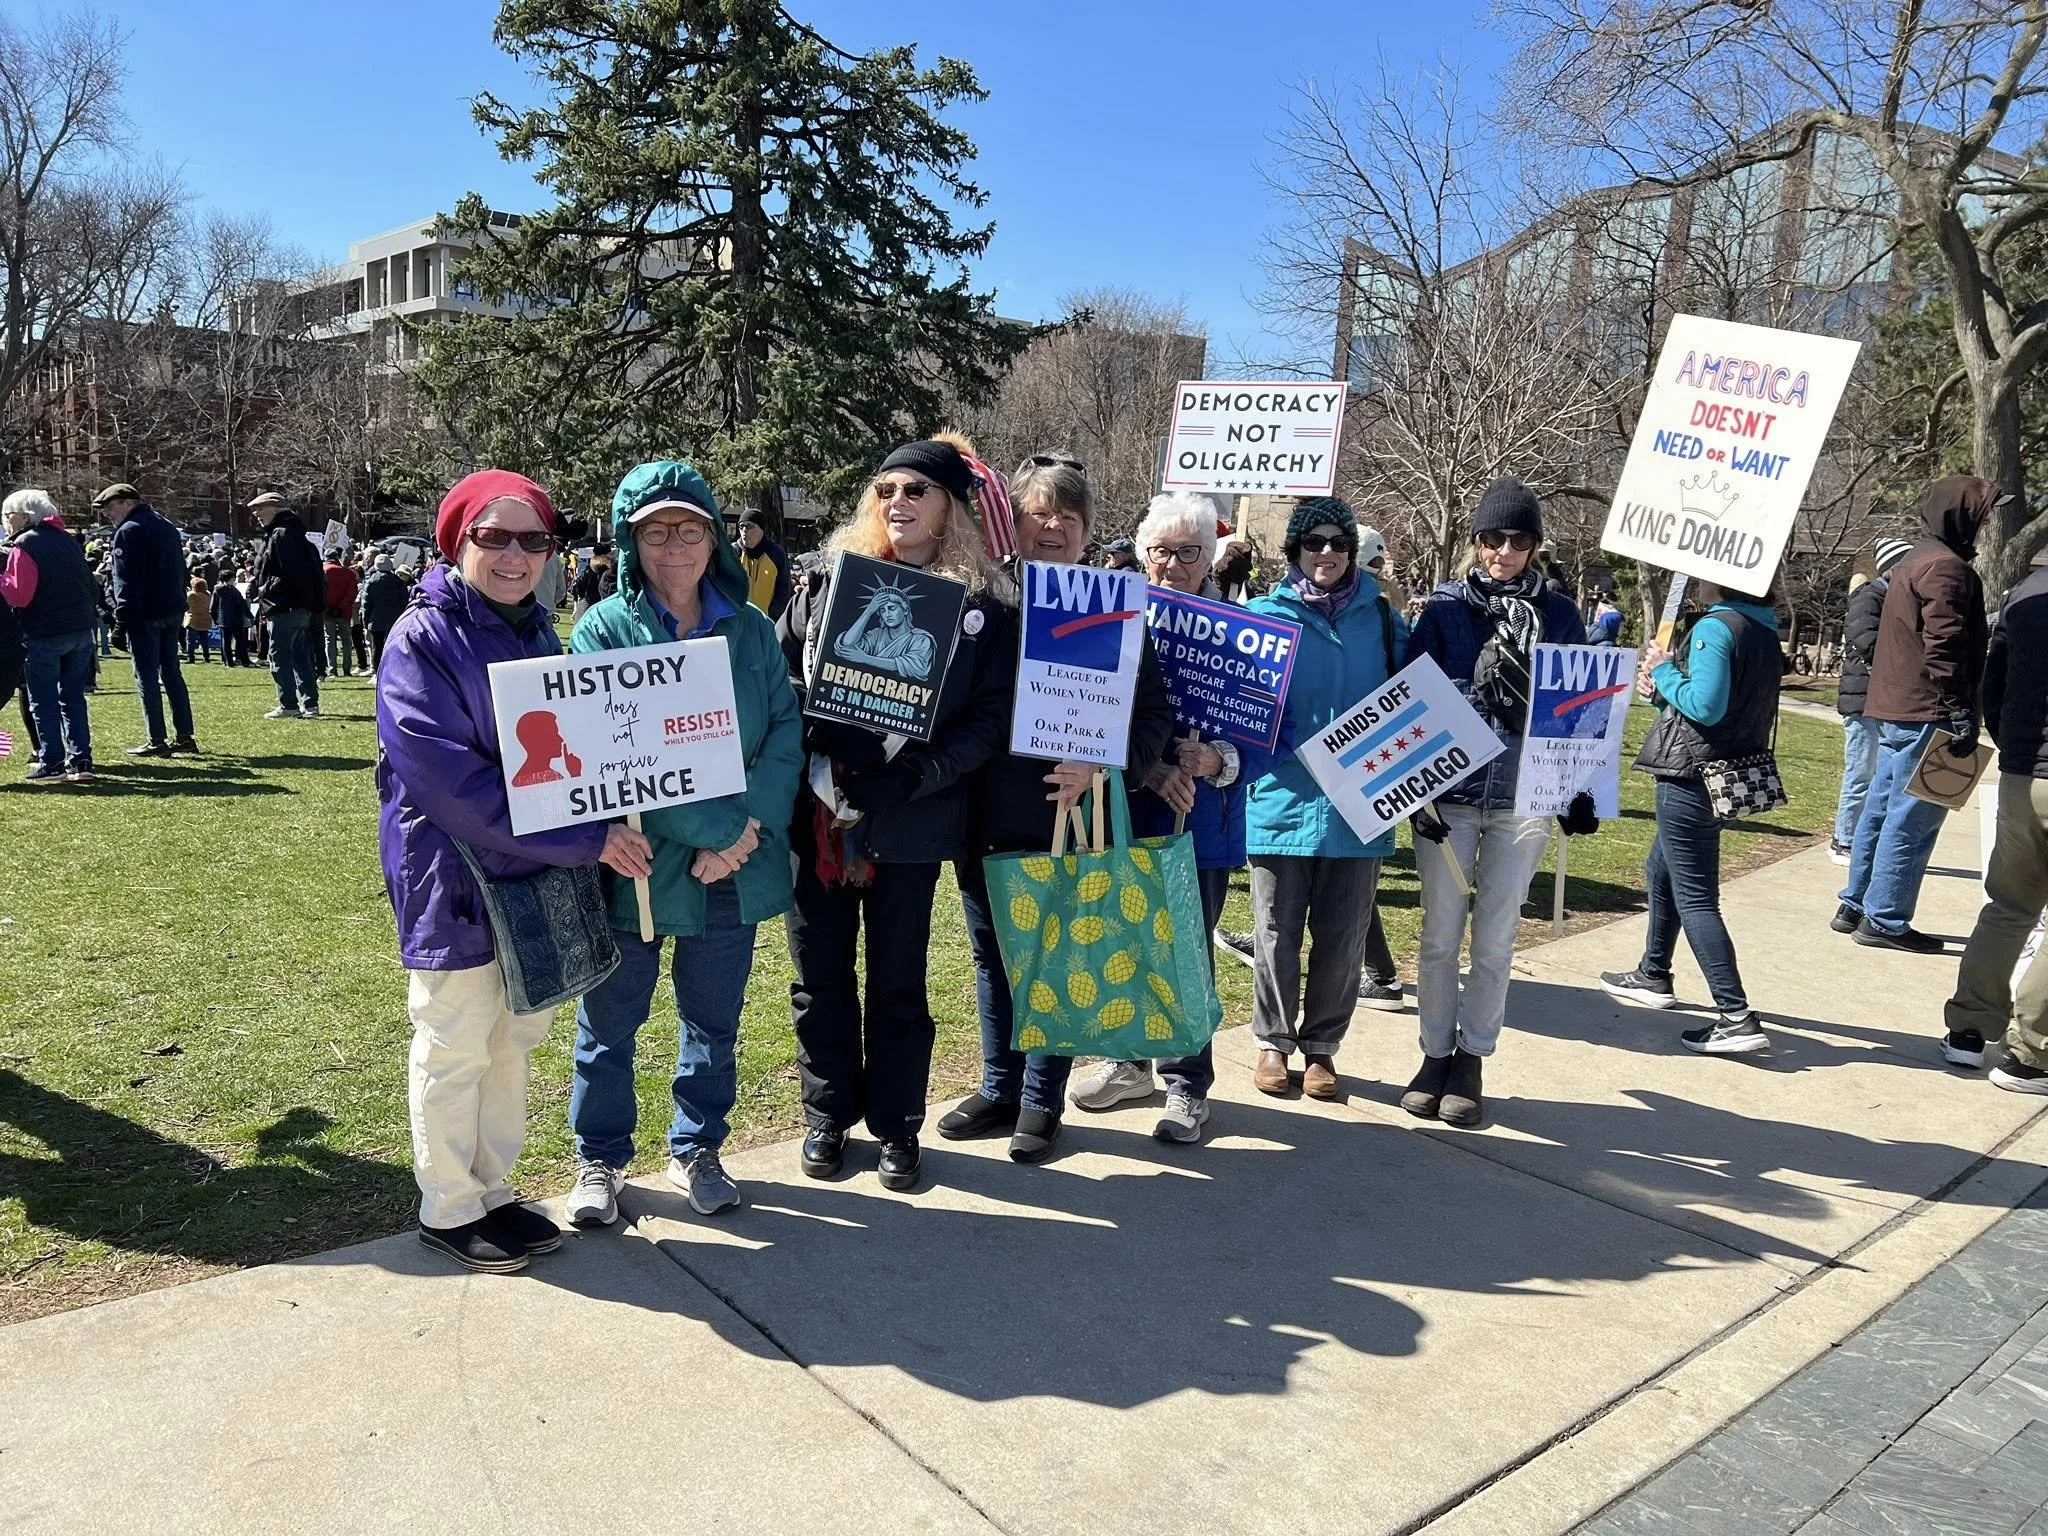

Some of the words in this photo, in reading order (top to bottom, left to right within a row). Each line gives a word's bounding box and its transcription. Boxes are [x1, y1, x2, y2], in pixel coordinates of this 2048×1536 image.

[1676, 350, 1810, 408] AMERICA
[1181, 392, 1339, 413] DEMOCRACY
[1227, 423, 1281, 443] NOT
[1178, 451, 1324, 473] OLIGARCHY
[1652, 429, 1704, 460] NEED
[1706, 447, 1726, 464] OR
[1731, 446, 1790, 481] WANT
[1619, 501, 1677, 545] KING
[1677, 518, 1764, 570] DONALD
[1032, 564, 1124, 614] LWV
[1145, 601, 1228, 646] HANDS
[1236, 627, 1291, 664] OFF
[542, 655, 686, 700] HISTORY
[1047, 665, 1092, 683] LEAGUE
[1094, 674, 1109, 686] OF
[1175, 643, 1283, 688] DEMOCRACY
[1178, 666, 1226, 689] MEDICARE
[1538, 649, 1620, 692] LWV
[821, 662, 933, 707] DEMOCRACY
[1030, 680, 1075, 699] WOMEN
[1079, 688, 1120, 706] VOTERS
[604, 693, 639, 720] does
[830, 686, 846, 702] IS
[847, 690, 861, 706] IN
[862, 694, 915, 720] DANGER
[1067, 707, 1080, 717] OF
[1186, 684, 1221, 704] SOCIAL
[1223, 696, 1271, 719] SECURITY
[664, 709, 731, 735] RESIST!
[814, 699, 852, 716] PROTECT
[854, 708, 871, 721] OUR
[873, 714, 924, 734] DEMOCRACY
[1034, 718, 1060, 733] OAK
[1064, 722, 1093, 738] PARK
[1095, 727, 1106, 740] &
[1206, 705, 1268, 733] HEALTHCARE
[1322, 705, 1380, 754] HANDS
[1377, 680, 1411, 713] OFF
[613, 718, 640, 747] not
[664, 737, 685, 746] WHILE
[686, 734, 701, 743] YOU
[703, 731, 719, 740] STILL
[720, 729, 734, 737] CAN
[1546, 739, 1583, 751] LEAGUE
[1029, 736, 1064, 752] RIVER
[1067, 741, 1107, 758] FOREST
[1532, 755, 1569, 766] WOMEN
[1572, 756, 1607, 767] VOTERS
[599, 754, 658, 786] forgive
[1372, 746, 1471, 822] CHICAGO
[569, 768, 695, 816] SILENCE
[1534, 785, 1554, 796] OAK
[1529, 801, 1557, 811] RIVER
